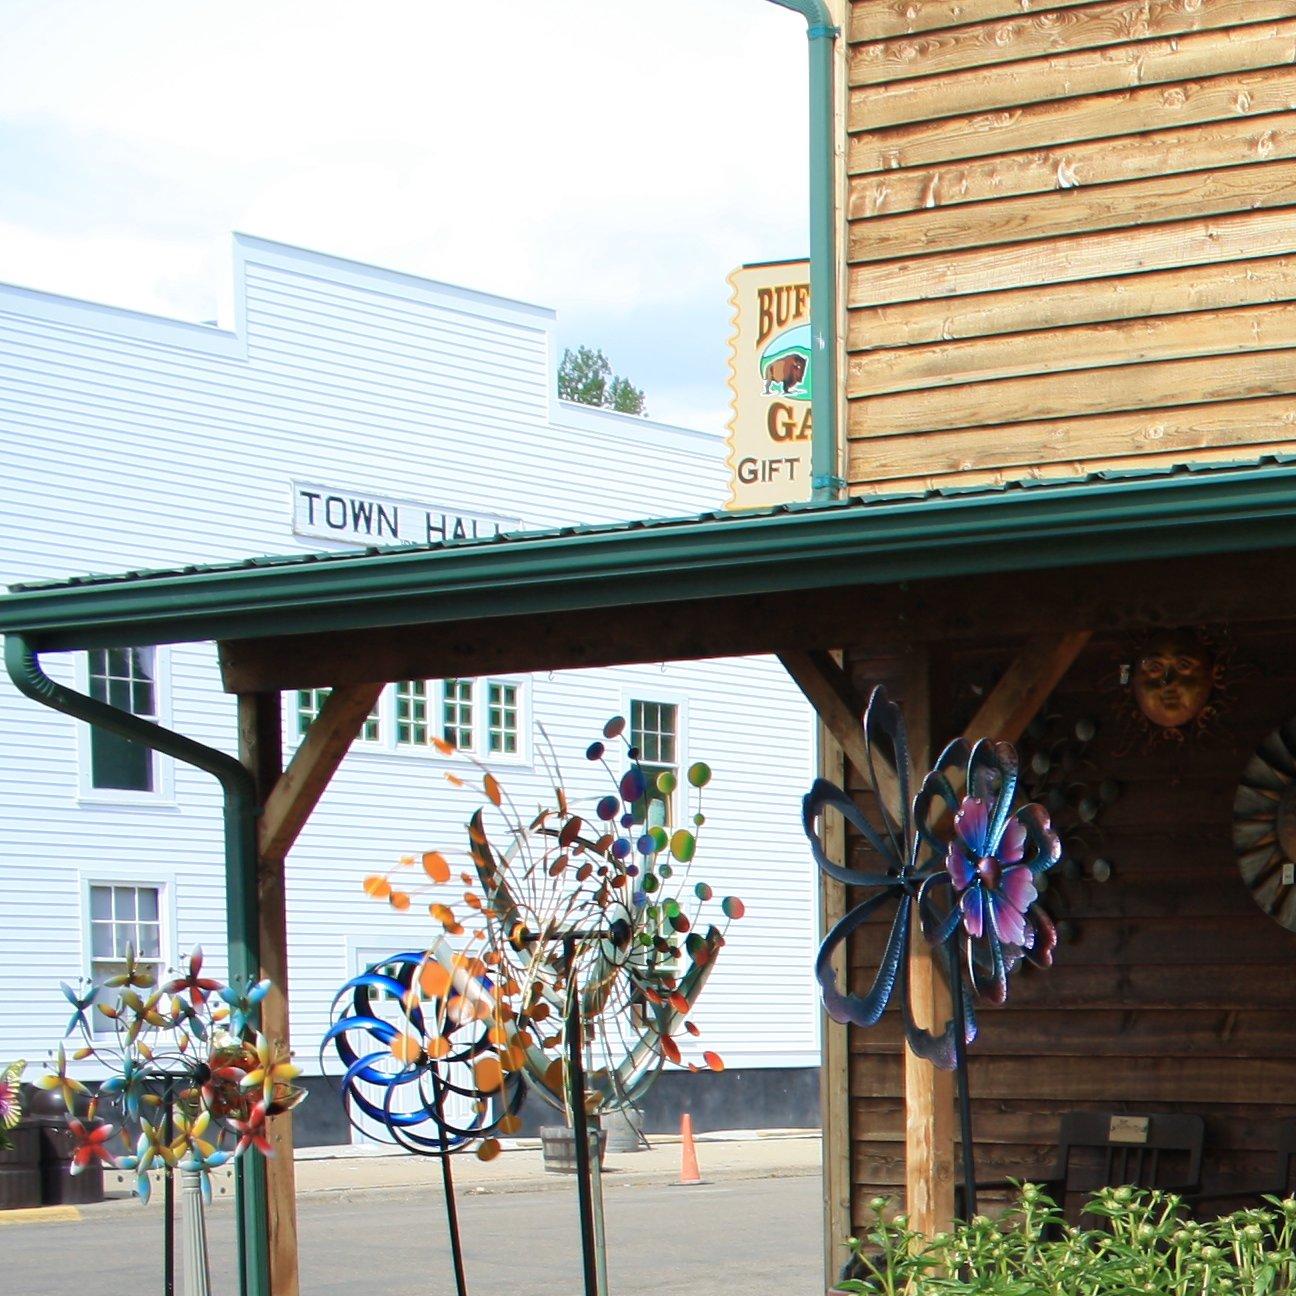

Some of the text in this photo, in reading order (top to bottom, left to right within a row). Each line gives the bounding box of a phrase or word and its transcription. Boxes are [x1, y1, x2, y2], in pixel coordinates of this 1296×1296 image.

[737, 457, 801, 484] GIFT
[300, 490, 500, 545] TOWN HA
